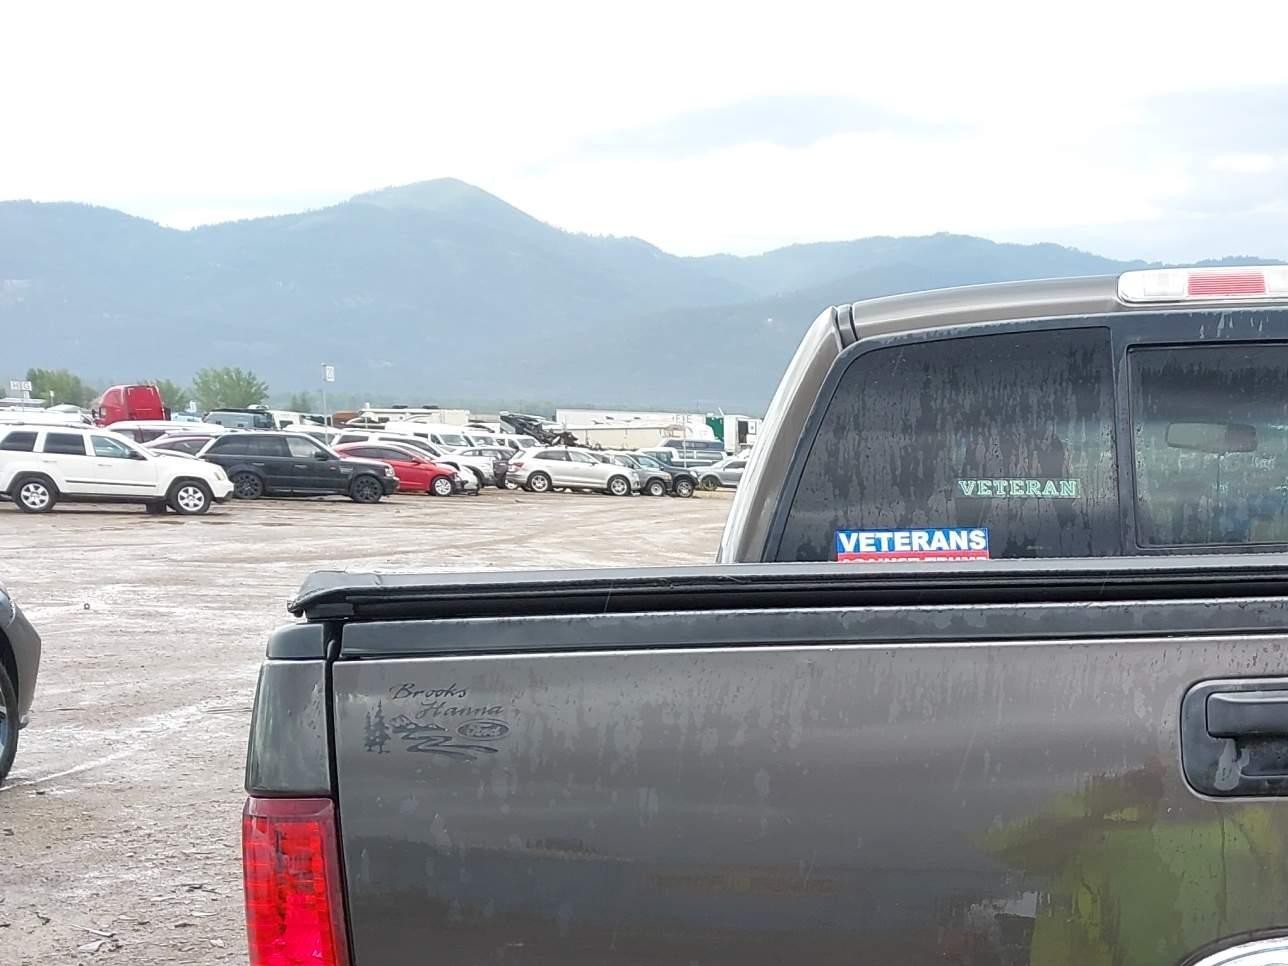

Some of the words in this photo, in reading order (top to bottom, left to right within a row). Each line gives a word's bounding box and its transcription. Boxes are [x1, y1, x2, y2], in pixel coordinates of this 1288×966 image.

[958, 479, 1077, 496] VETERAN
[838, 530, 986, 552] VETERANS
[392, 683, 467, 700] Brooks
[415, 701, 502, 719] Hanna
